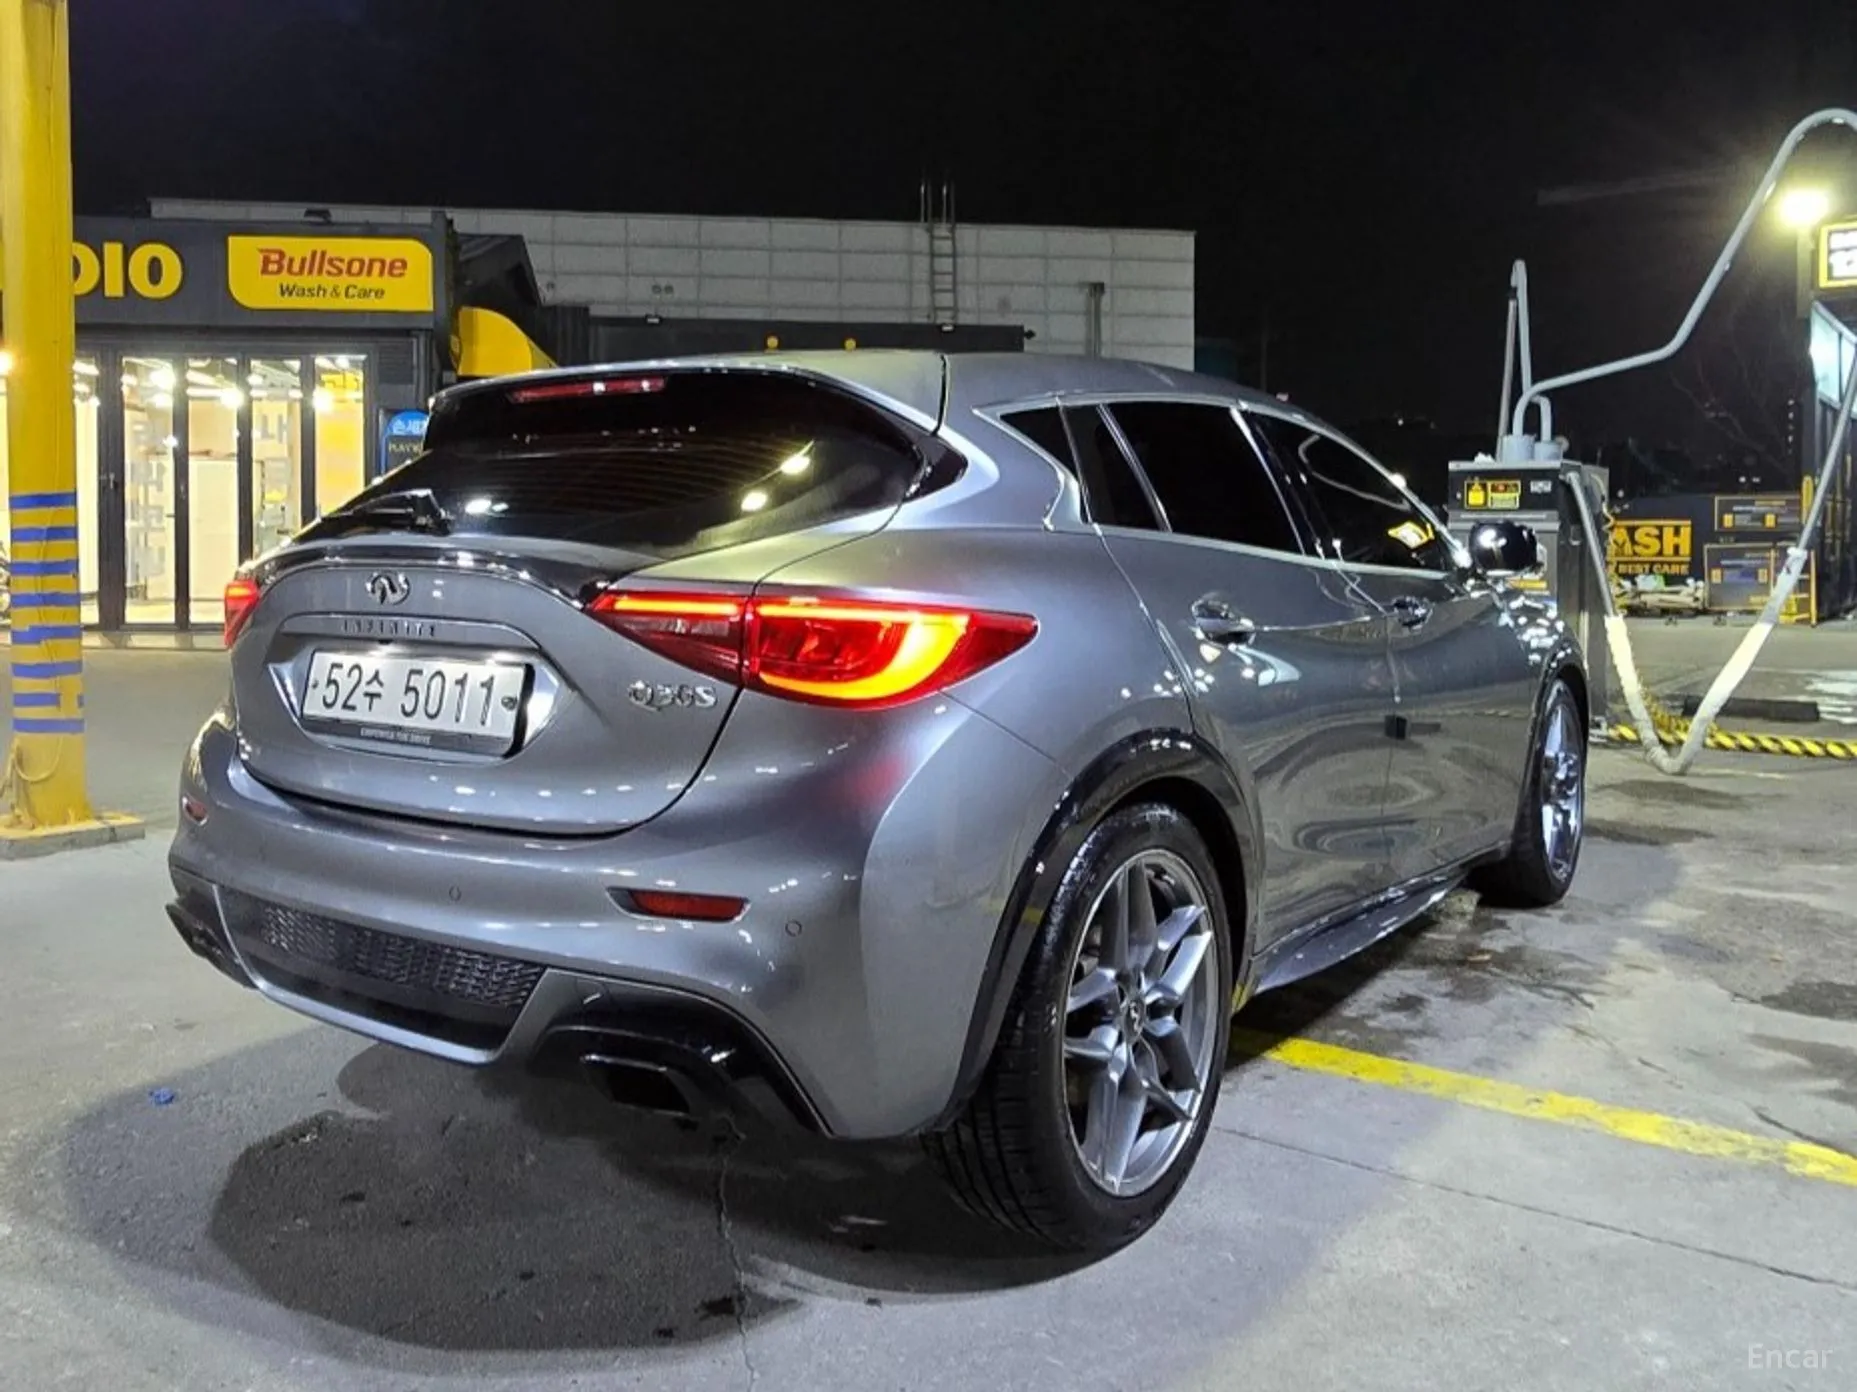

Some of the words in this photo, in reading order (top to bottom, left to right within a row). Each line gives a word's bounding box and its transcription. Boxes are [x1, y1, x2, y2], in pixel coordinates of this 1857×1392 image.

[257, 248, 408, 278] Bullsone
[279, 283, 326, 298] Wash
[330, 286, 341, 298] &
[344, 284, 385, 300] Care
[1652, 564, 1689, 575] CARE
[342, 619, 436, 637] INFINITI
[322, 662, 384, 712] 52수
[400, 668, 495, 726] 5011
